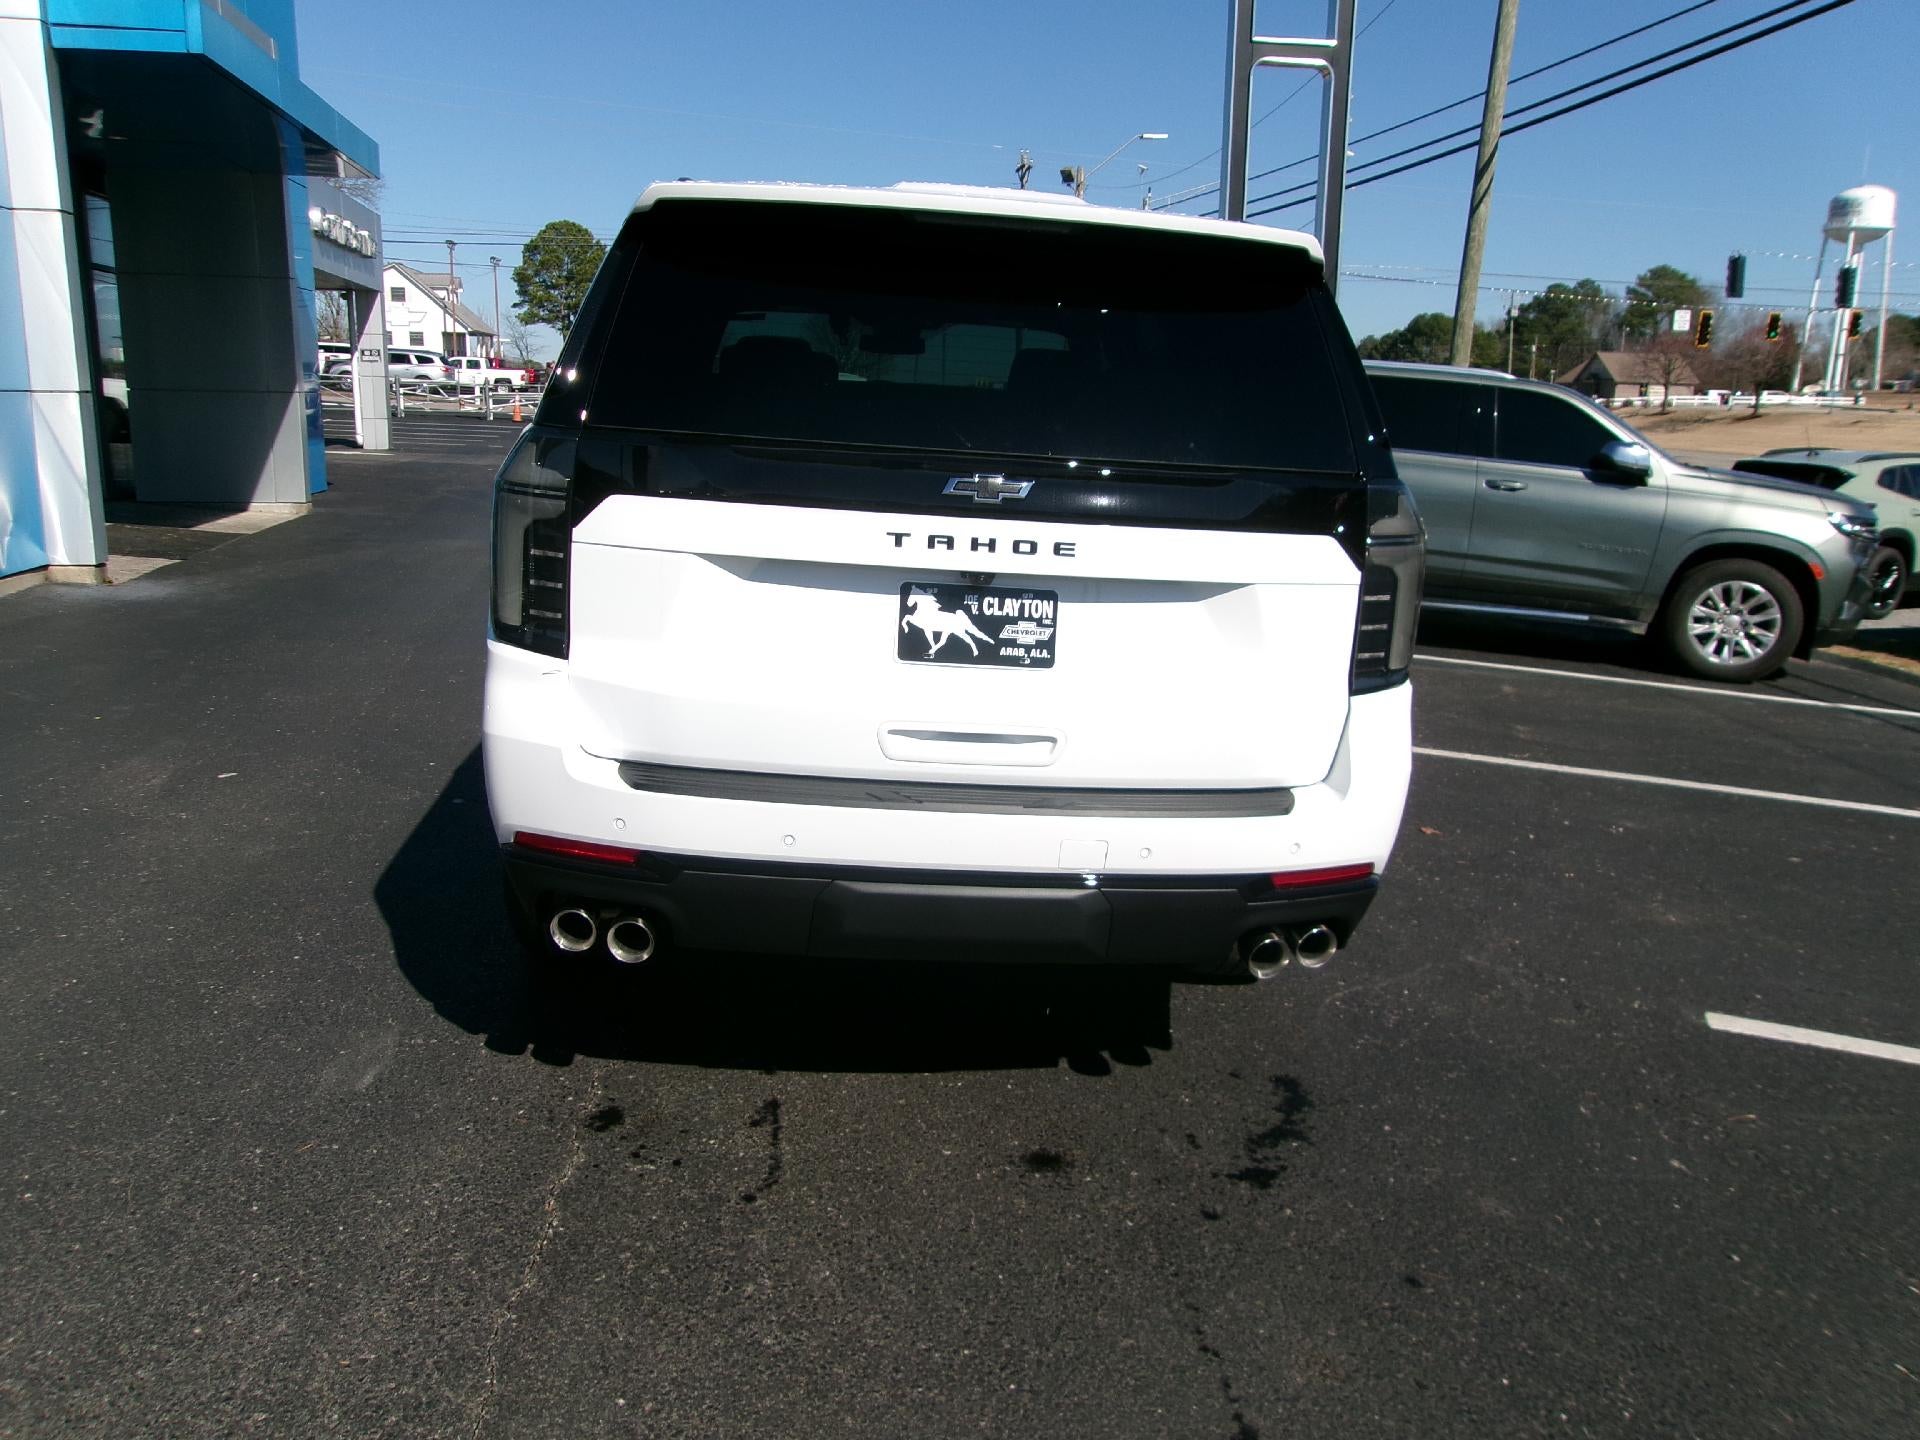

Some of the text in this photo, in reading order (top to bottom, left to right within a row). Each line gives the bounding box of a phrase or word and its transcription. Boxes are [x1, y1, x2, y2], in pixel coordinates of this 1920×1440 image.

[886, 531, 1076, 557] TAHOE
[964, 594, 979, 605] JOE
[982, 596, 1054, 619] CLAYTON
[1006, 627, 1047, 637] CHEVROLET
[1000, 646, 1051, 659] ARAB, ALA.
